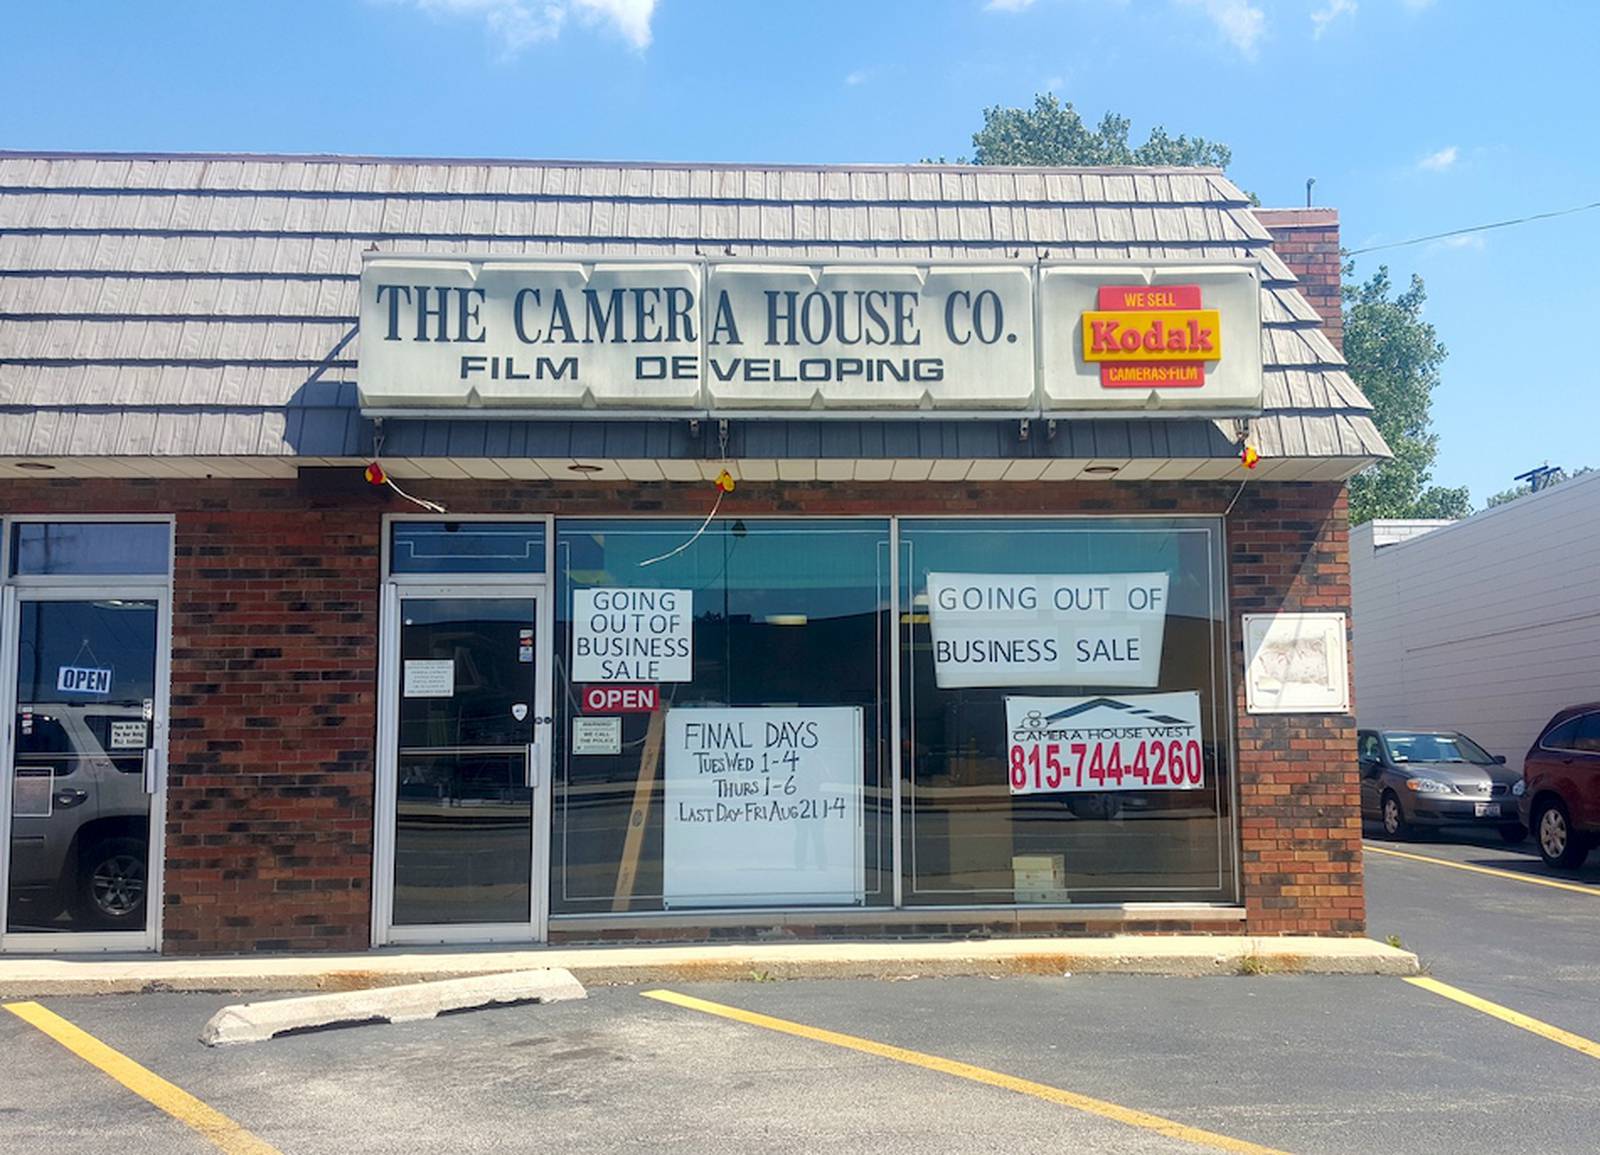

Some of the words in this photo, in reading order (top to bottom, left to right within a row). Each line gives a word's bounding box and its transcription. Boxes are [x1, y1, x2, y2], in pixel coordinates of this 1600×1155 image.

[1124, 293, 1145, 307] WE
[1147, 292, 1176, 307] SELL
[376, 284, 487, 343] THE
[513, 286, 744, 346] CAMERA
[764, 289, 921, 346] HOUSE
[944, 289, 1018, 346] CO.
[1090, 319, 1213, 353] Kodak
[460, 356, 579, 380] FILM
[635, 356, 944, 382] DEVELOPING
[593, 591, 676, 612] GOING
[938, 586, 1038, 610] GOING
[1053, 587, 1110, 610] OUT
[1128, 587, 1162, 610] OF
[590, 613, 645, 634] OUT
[649, 614, 681, 634] OF
[576, 636, 690, 658] BUSINESS
[936, 639, 1058, 663] BUSINESS
[1076, 638, 1141, 662] SALE
[63, 669, 108, 692] OPEN
[601, 660, 660, 681] SALE
[588, 689, 655, 709] OPEN
[684, 721, 753, 750] FINAL
[765, 721, 819, 749] DAYS
[1013, 729, 1084, 742] CAMERA
[1088, 728, 1143, 740] HOUSE
[1148, 726, 1194, 739] WEST
[760, 750, 800, 774] 1-4
[1010, 740, 1201, 790] 815-744-4260
[713, 778, 760, 798] THURS
[762, 775, 798, 797] 1-6
